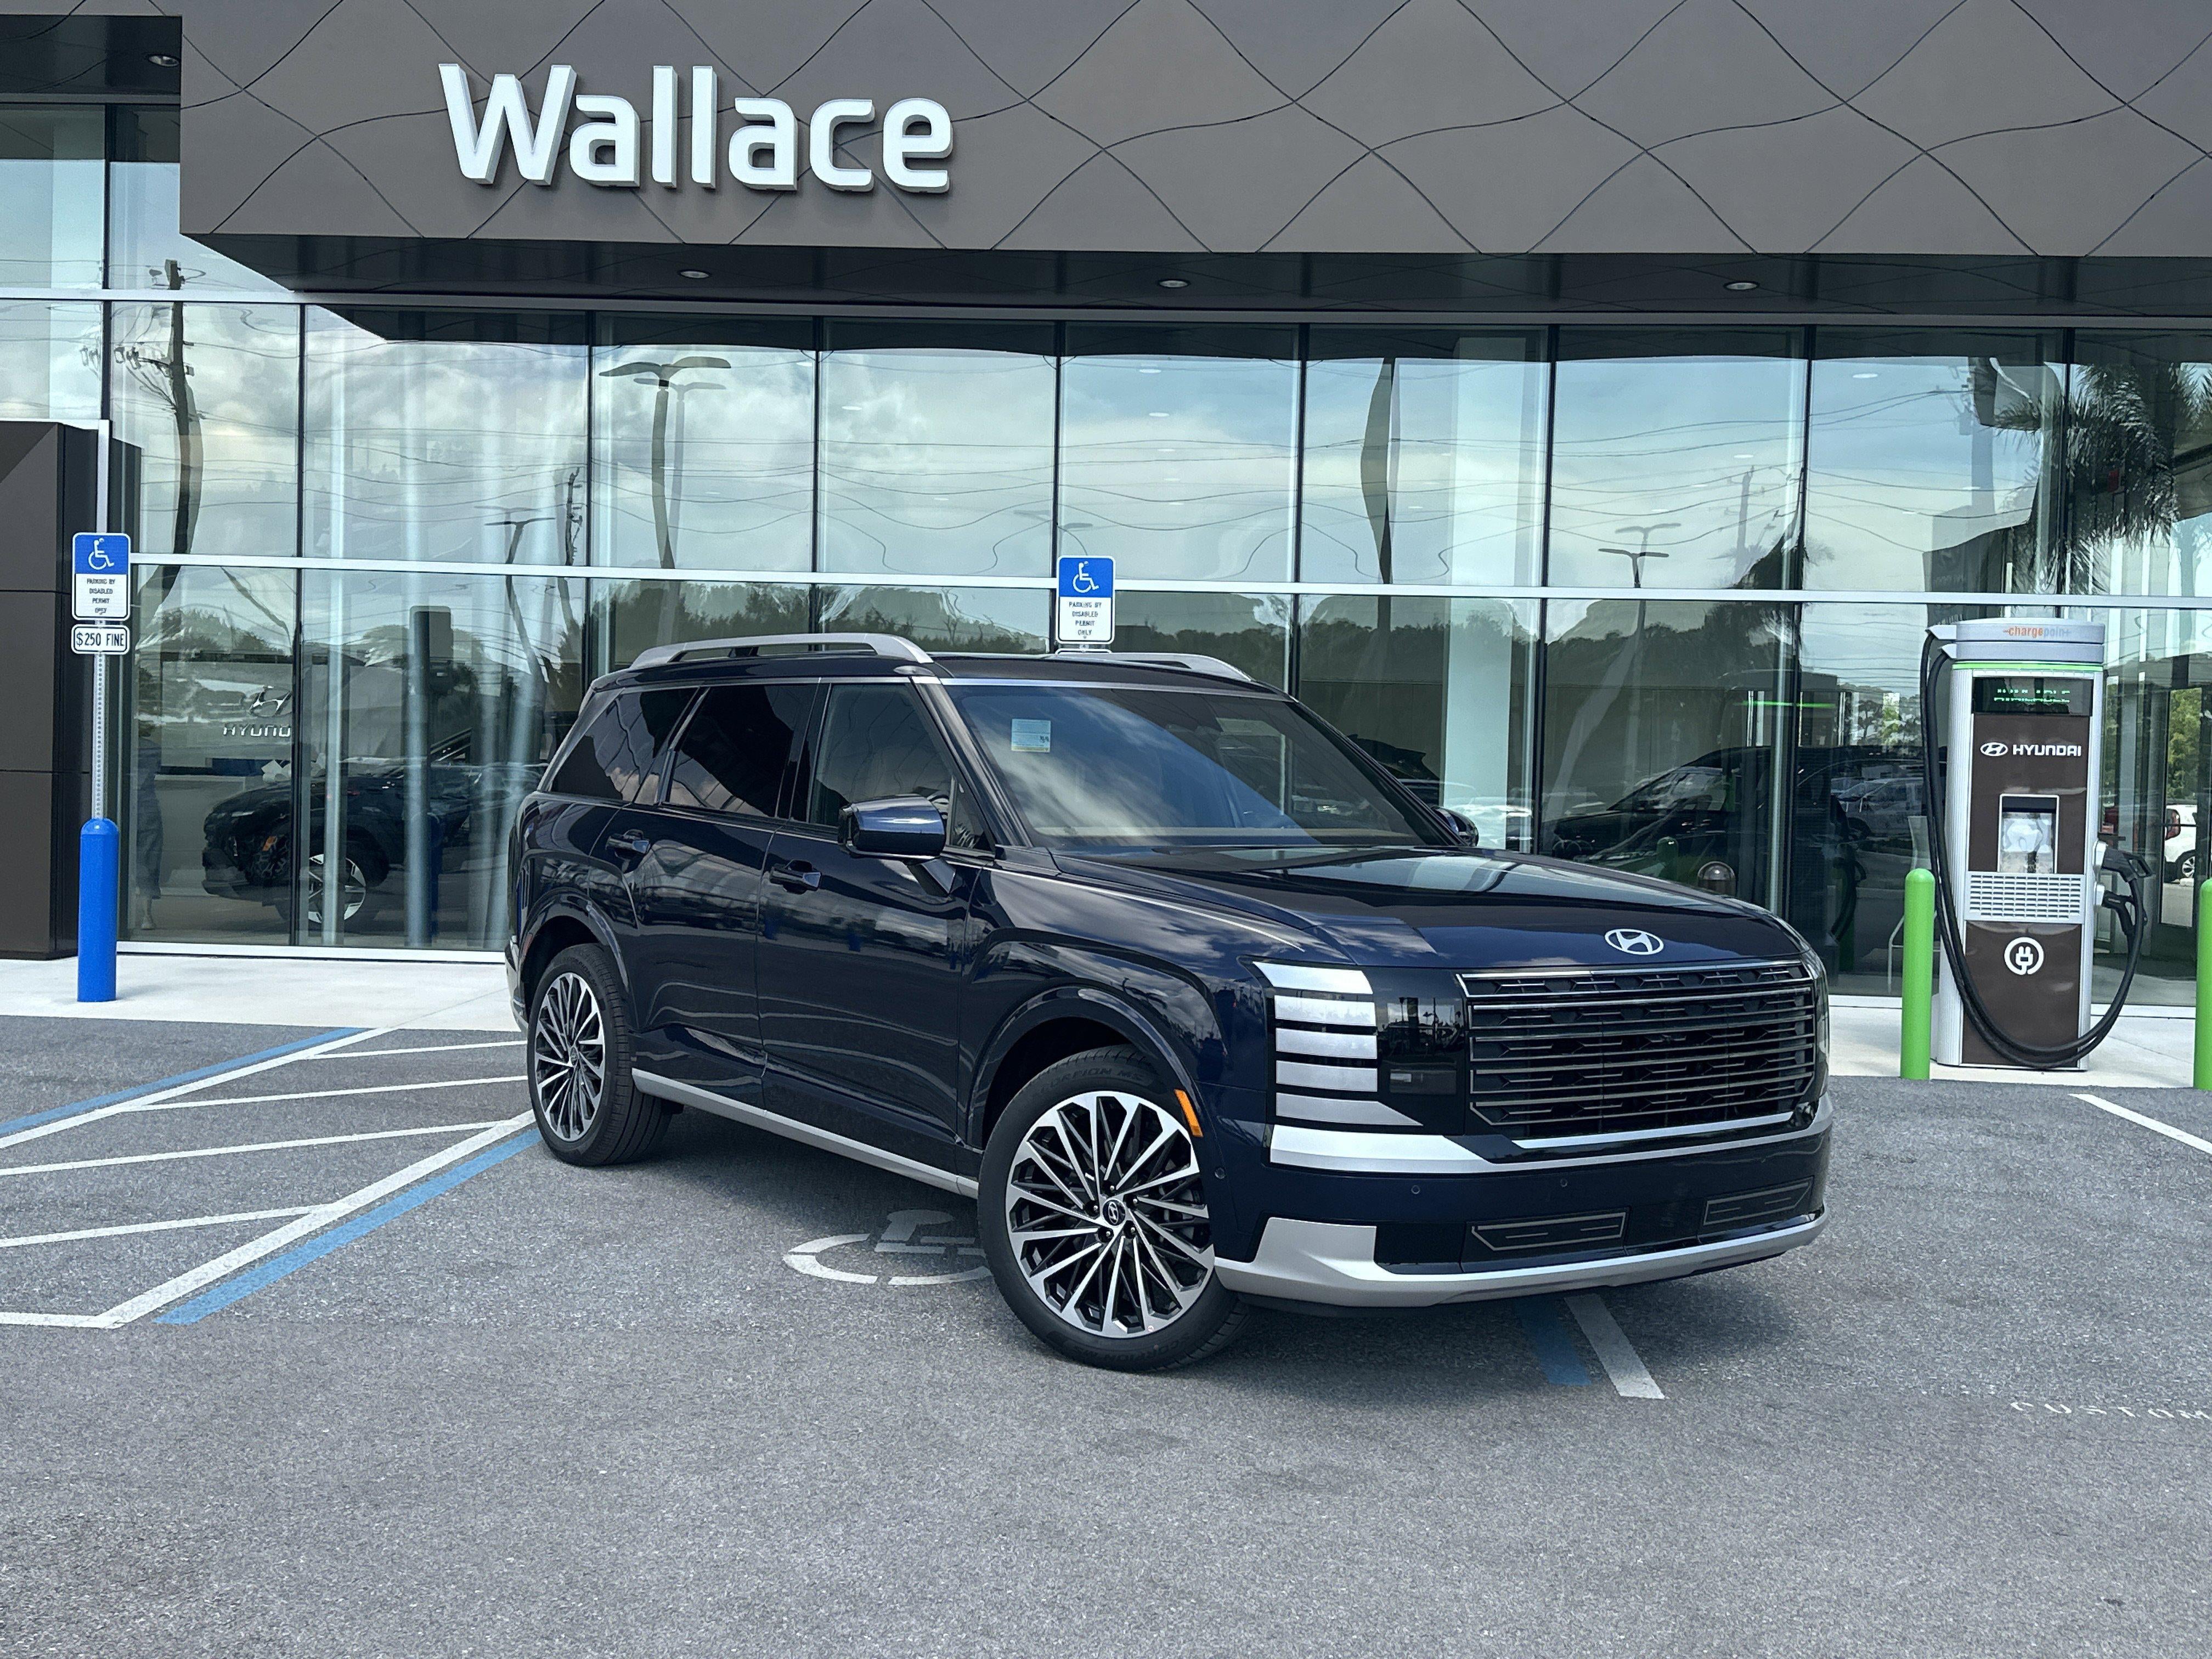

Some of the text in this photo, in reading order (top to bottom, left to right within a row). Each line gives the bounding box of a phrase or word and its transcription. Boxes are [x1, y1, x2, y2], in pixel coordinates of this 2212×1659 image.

[438, 63, 953, 194] Wallace
[76, 631, 125, 647] $250 FINE
[223, 724, 291, 737] HYUND
[2012, 744, 2081, 757] HYUNDAI
